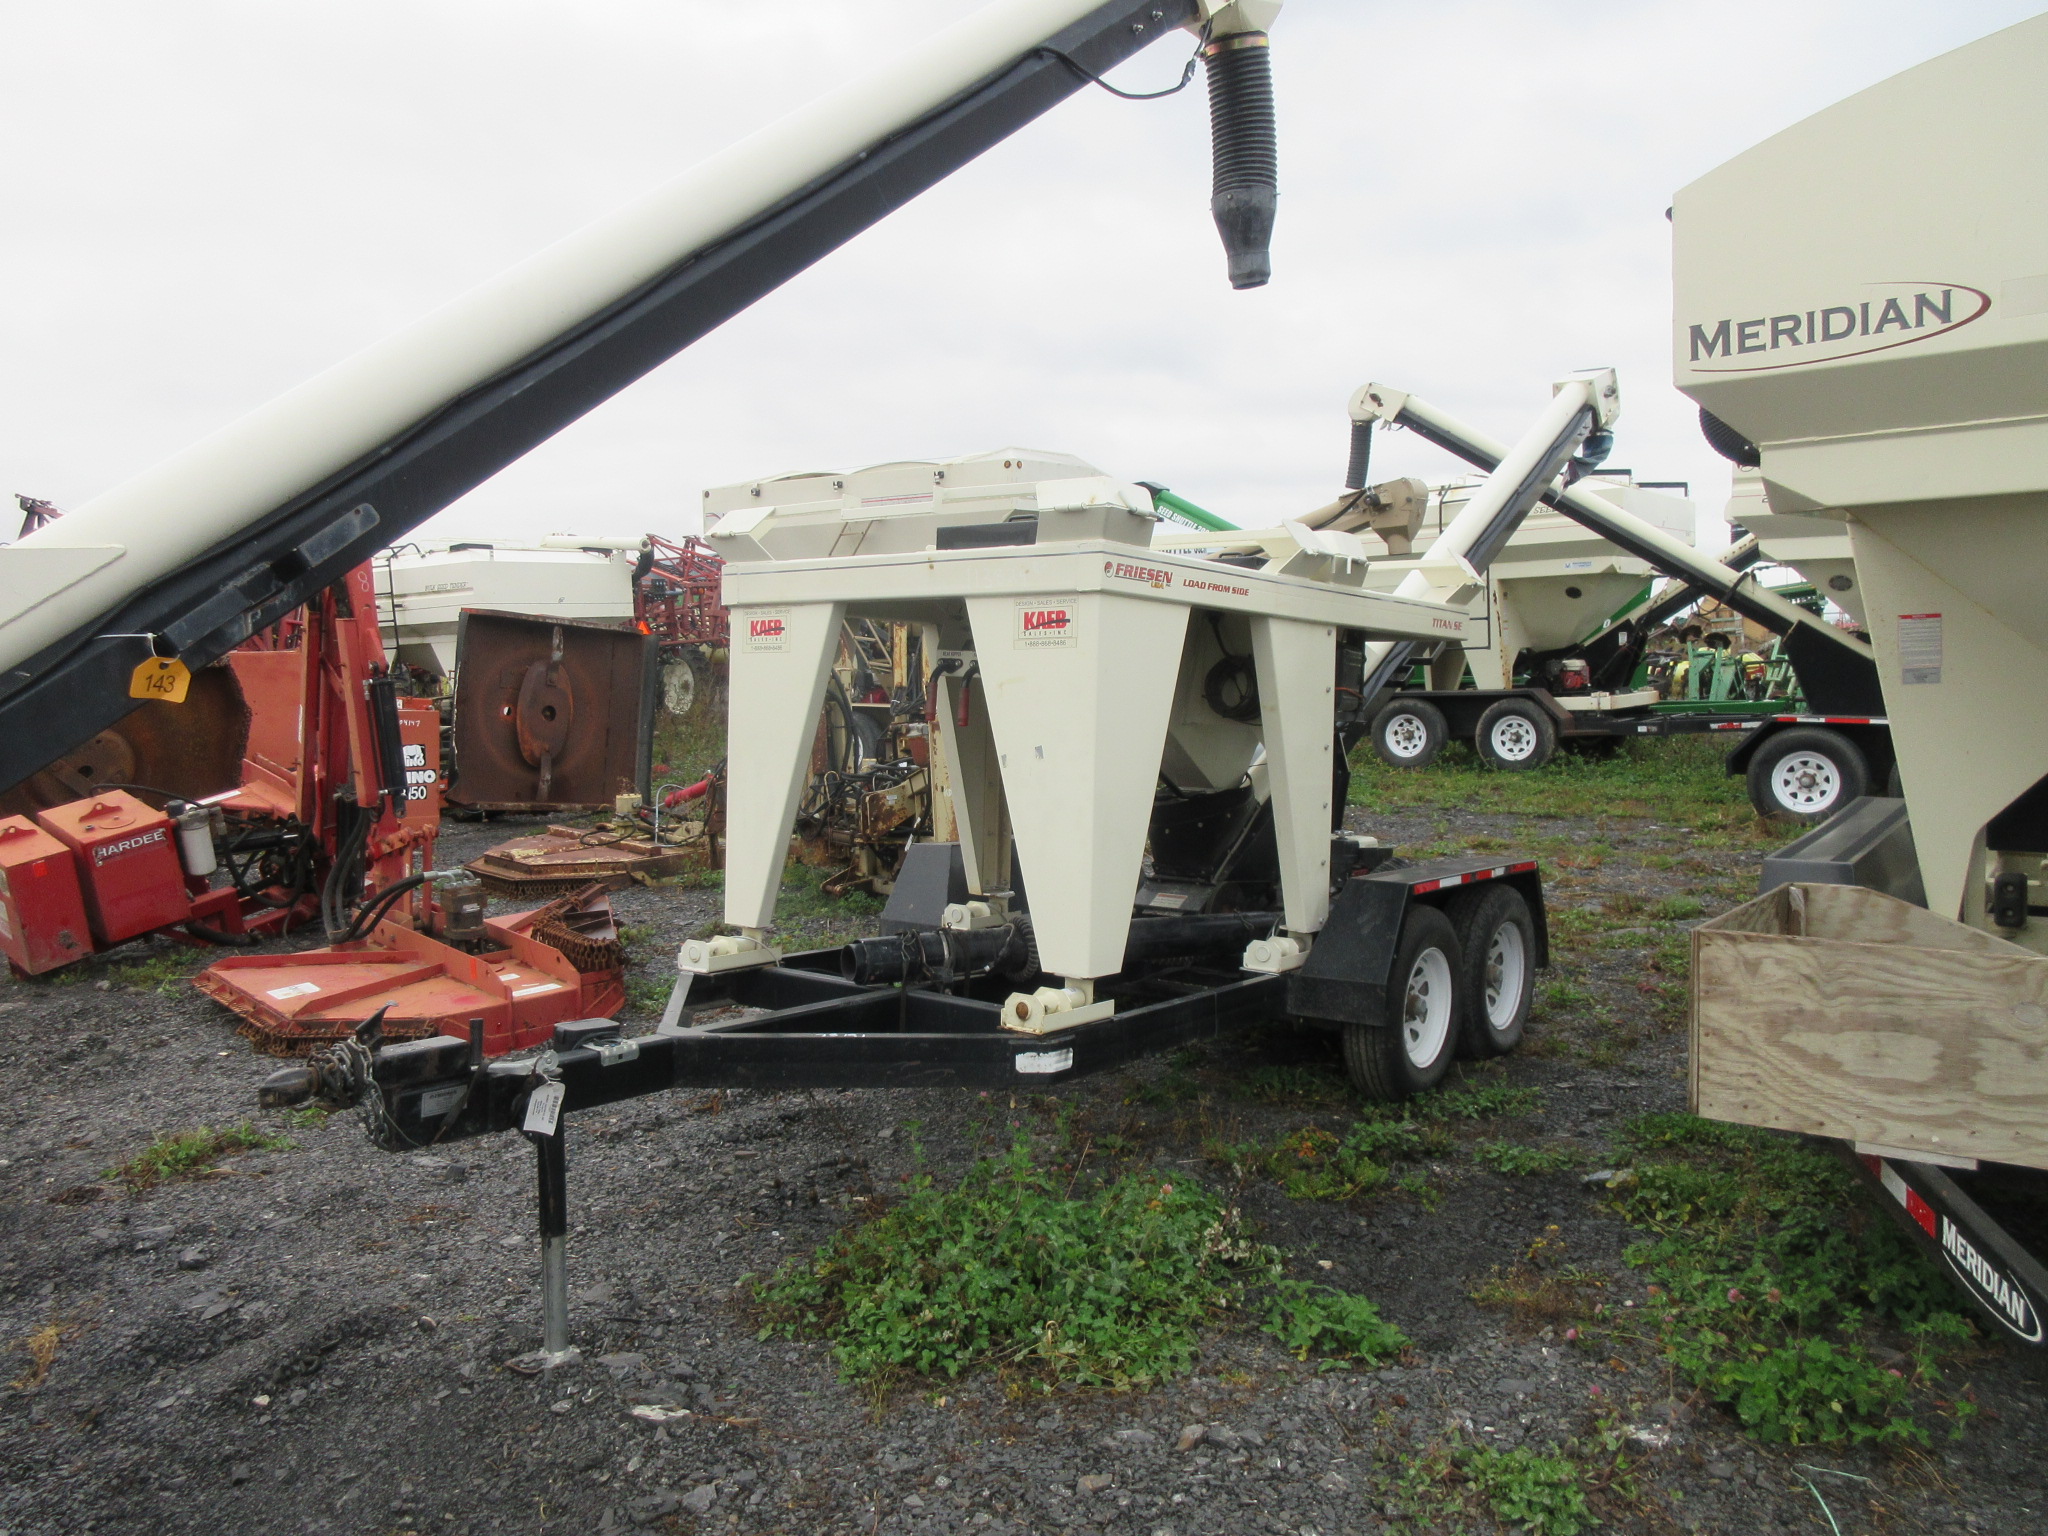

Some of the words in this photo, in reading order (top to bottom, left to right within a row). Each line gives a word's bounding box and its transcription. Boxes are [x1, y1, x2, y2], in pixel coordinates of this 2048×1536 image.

[1689, 288, 1953, 362] MERIDIAN
[1156, 505, 1174, 519] SEED
[1171, 512, 1198, 531] SHUTTLE
[1534, 505, 1556, 515] SEE
[1115, 563, 1173, 583] FRIESEN
[1183, 579, 1207, 590] LOAD
[1207, 583, 1231, 594] FROM
[1231, 587, 1250, 597] SIDE
[750, 619, 783, 637] KAEB
[1023, 610, 1068, 631] KAEB
[1432, 618, 1453, 630] TITAN
[1453, 621, 1463, 631] SE
[145, 674, 176, 693] 143
[98, 831, 164, 857] HARDEE
[1942, 1214, 2025, 1329] MERIDIAN
